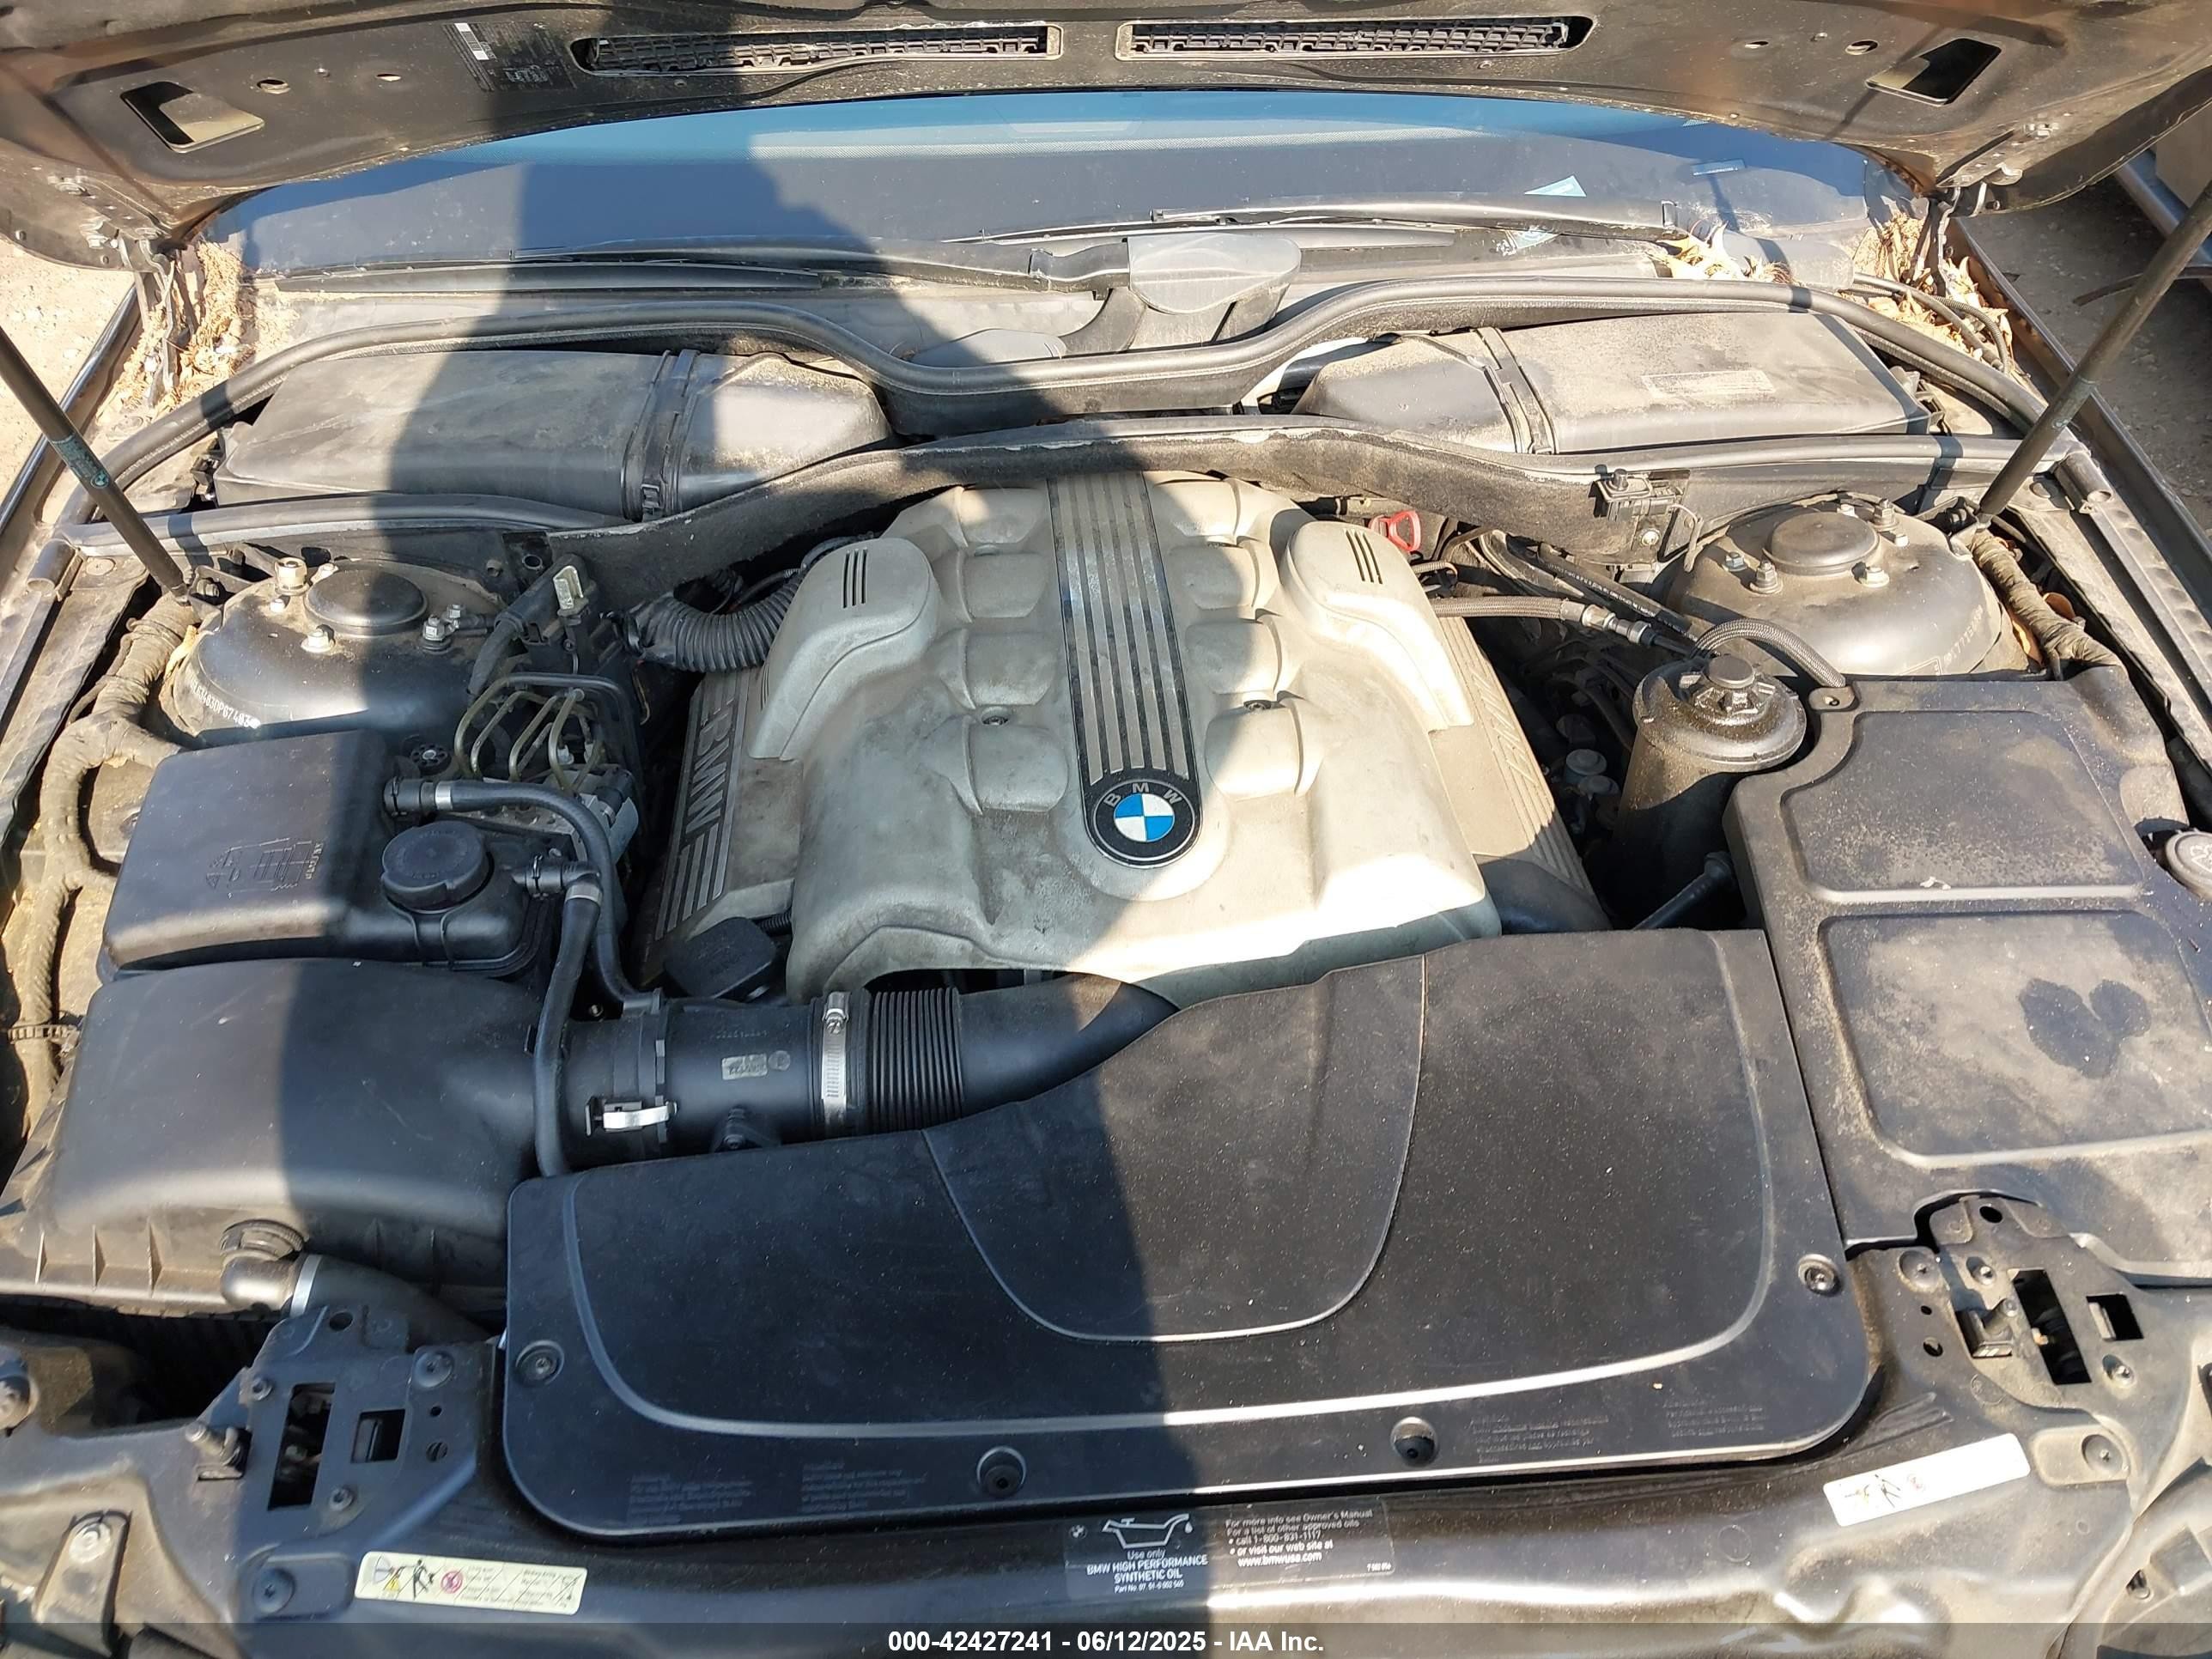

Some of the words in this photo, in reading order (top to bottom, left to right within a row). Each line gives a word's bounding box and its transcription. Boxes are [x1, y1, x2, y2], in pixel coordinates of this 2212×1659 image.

[685, 711, 732, 835] BMW
[1103, 781, 1183, 808] BMW
[1225, 1518, 1240, 1528] For
[1243, 1517, 1266, 1527] more
[1267, 1515, 1285, 1525] info
[1285, 1515, 1302, 1524] see
[1303, 1511, 1340, 1522] Owner's
[1340, 1509, 1373, 1519] Manual
[1226, 1528, 1242, 1537] For
[1251, 1526, 1265, 1535] list
[1267, 1524, 1276, 1534] of
[1277, 1523, 1299, 1533] other
[1303, 1519, 1342, 1533] approved
[1343, 1518, 1360, 1528] oils
[1236, 1535, 1252, 1546] call
[1254, 1529, 1322, 1545] 1-800-831-1117
[1127, 1550, 1146, 1560] Use
[1146, 1548, 1166, 1560] only
[1237, 1547, 1248, 1557] or
[1248, 1544, 1267, 1556] visit
[1268, 1545, 1285, 1554] our
[1285, 1541, 1305, 1553] web
[1305, 1540, 1323, 1551] site
[1323, 1539, 1334, 1550] at
[1086, 1563, 1111, 1575] BMW
[1112, 1561, 1136, 1573] HIGH
[1137, 1554, 1209, 1571] PERFORMANCE
[1237, 1552, 1322, 1567] www.bmwusa.com
[1114, 1569, 1165, 1584] SYNTHETIC
[1166, 1567, 1183, 1579] OIL
